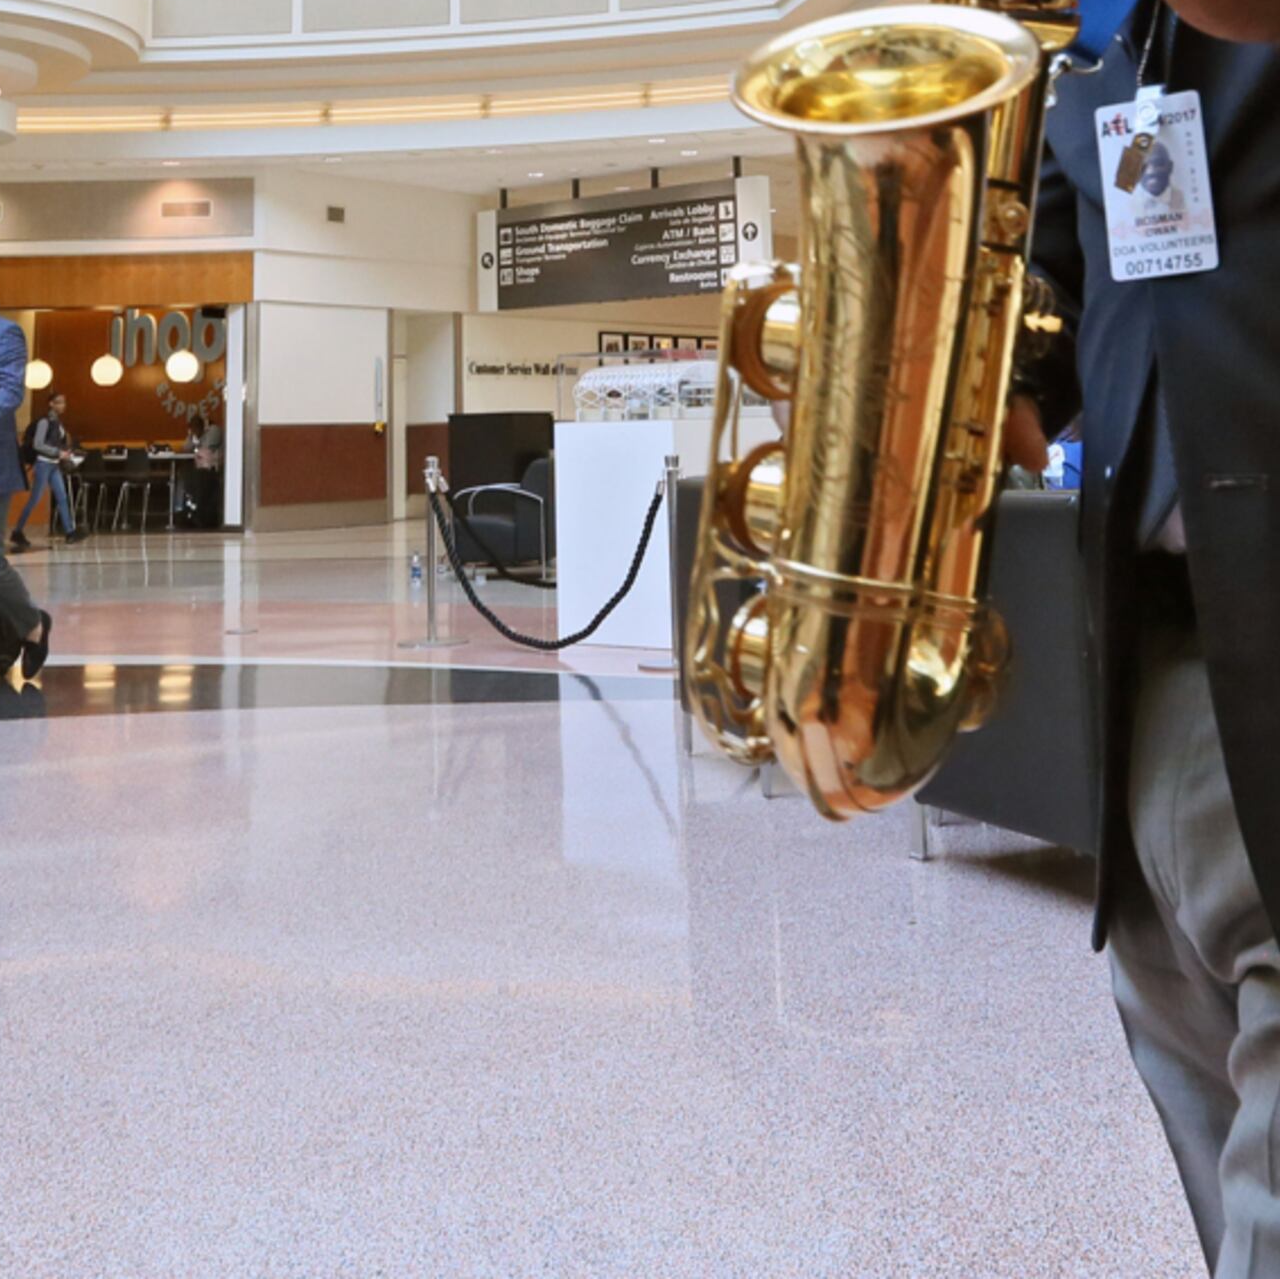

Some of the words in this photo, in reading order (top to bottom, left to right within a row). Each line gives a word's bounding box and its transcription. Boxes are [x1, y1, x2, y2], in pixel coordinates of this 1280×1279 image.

[650, 208, 685, 221] Arrivals
[687, 202, 716, 216] Lobby
[540, 220, 578, 233] Domestic
[579, 217, 616, 230] Baggage
[618, 213, 644, 225] Claim
[662, 229, 685, 241] ATM
[693, 224, 716, 237] Bank
[515, 245, 546, 256] Ground
[547, 238, 609, 253] Transportation
[1140, 233, 1214, 255] VOLUNTEERS
[631, 253, 671, 266] Currency
[673, 247, 717, 262] Exchange
[1125, 252, 1204, 276] 00714755
[669, 270, 717, 284] Restrooms
[468, 361, 505, 376] Customer
[506, 361, 532, 376] Service
[533, 362, 550, 376] Wall
